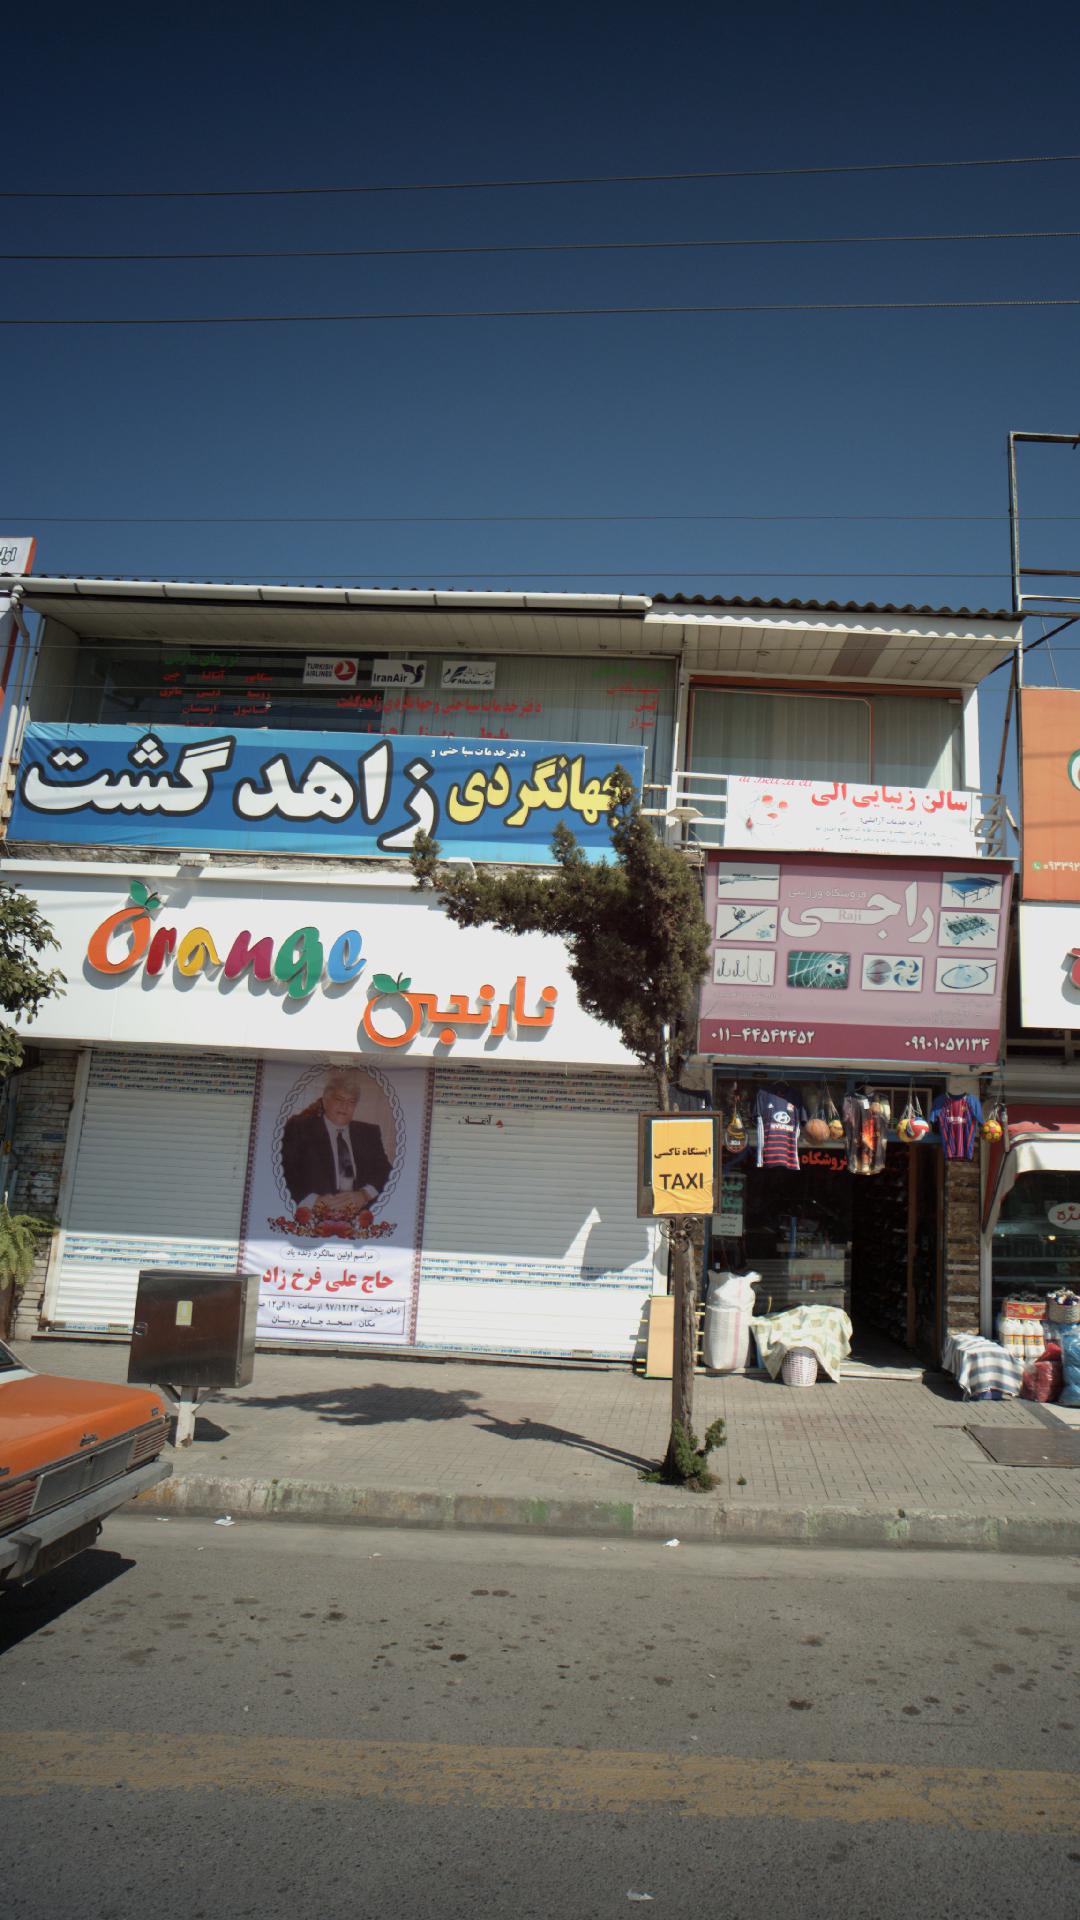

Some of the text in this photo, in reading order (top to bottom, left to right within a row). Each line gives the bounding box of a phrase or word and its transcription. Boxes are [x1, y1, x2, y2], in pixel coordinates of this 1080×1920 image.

[306, 662, 333, 671] TURKISH
[305, 669, 332, 678] AIRLINES
[373, 672, 408, 684] IranAir
[431, 749, 436, 758] و
[475, 747, 506, 757] خدمات
[506, 748, 526, 759] دفتر
[852, 784, 916, 811] زیبایی
[921, 790, 968, 814] سالن
[789, 887, 824, 899] ورزشی
[780, 880, 934, 943] راجی
[840, 909, 863, 922] Raji
[87, 906, 367, 999] Orange
[905, 1035, 991, 1051] ۰۹۹۰۱۰۵۷۱۳۴
[654, 1146, 712, 1159] ایستگاه تاکسی
[659, 1172, 703, 1190] TAXI
[286, 1248, 374, 1262] مراسم اولین سالگرد زنده یاد
[262, 1265, 287, 1290] زاد
[291, 1265, 322, 1291] فرخ
[325, 1268, 357, 1292] علی
[361, 1270, 394, 1294] حاج
[297, 1301, 316, 1311] ساعت
[317, 1303, 325, 1313] از
[300, 1315, 324, 1328] جامع
[325, 1317, 353, 1327] مسجد
[358, 1318, 376, 1328] مکان
